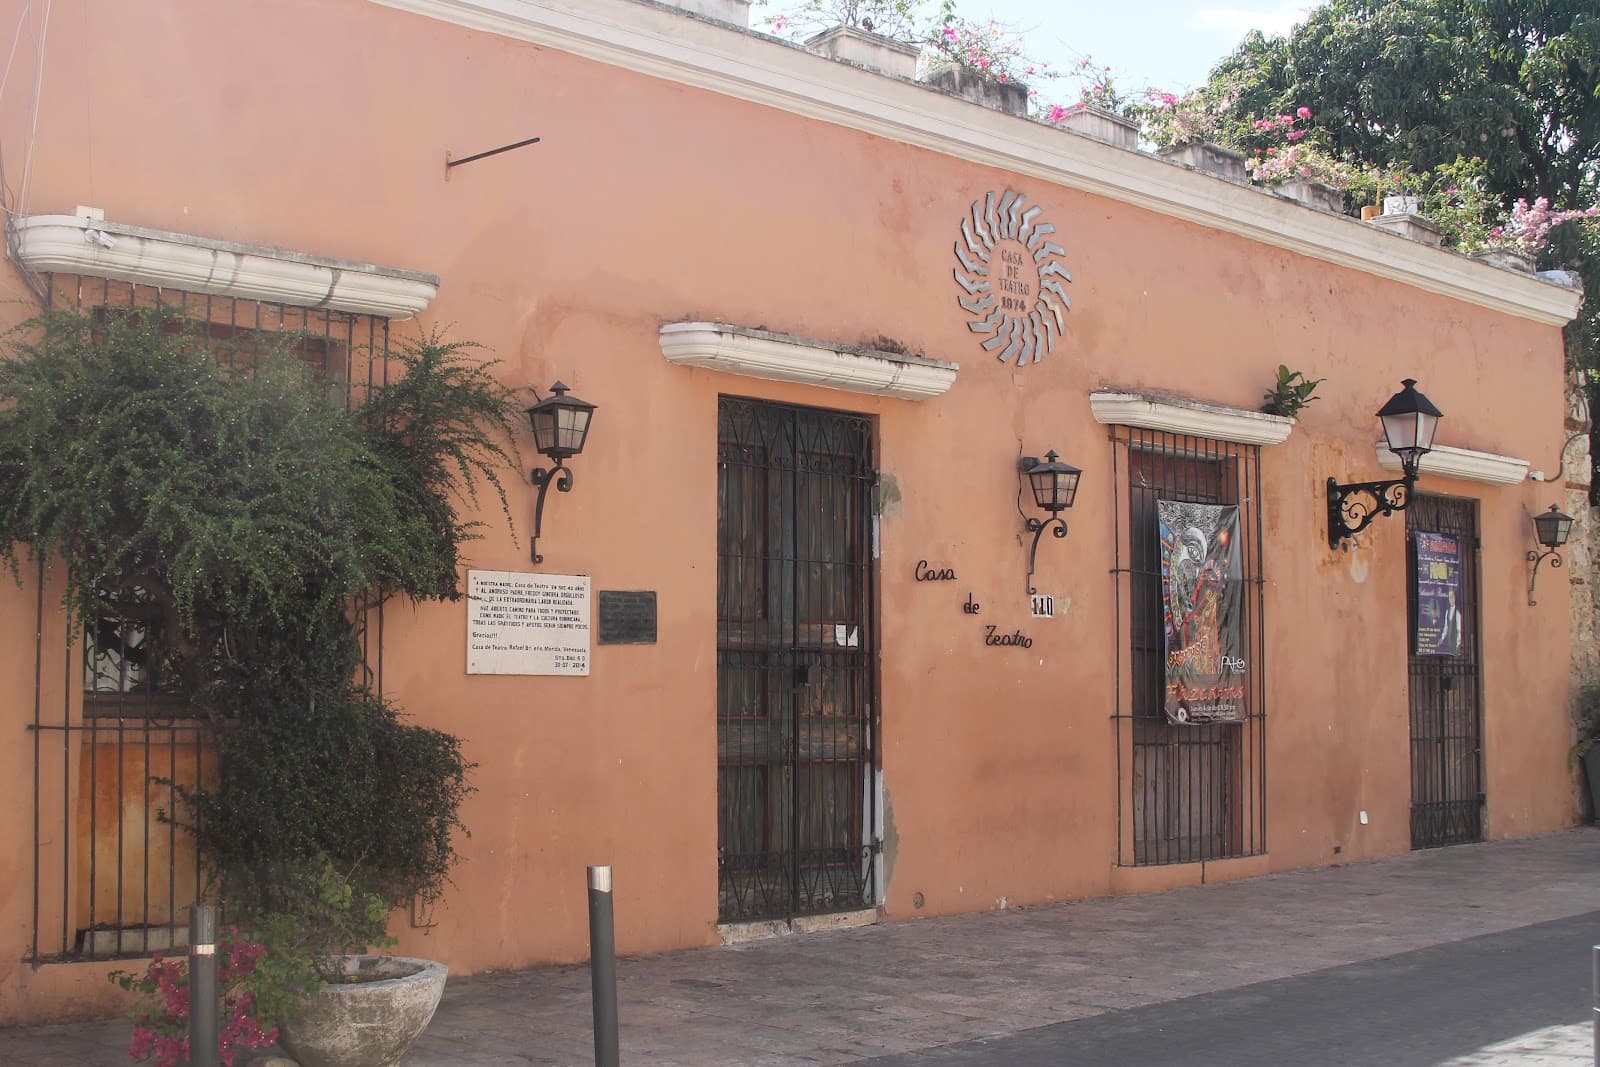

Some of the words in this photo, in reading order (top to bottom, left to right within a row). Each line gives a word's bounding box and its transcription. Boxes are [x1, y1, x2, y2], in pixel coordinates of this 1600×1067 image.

[1001, 248, 1024, 266] CASA
[1007, 265, 1019, 279] DE
[998, 278, 1030, 296] TEATRO
[915, 560, 958, 582] Casa
[964, 592, 980, 615] de
[1032, 596, 1053, 616] 110
[985, 625, 1033, 649] Teatro
